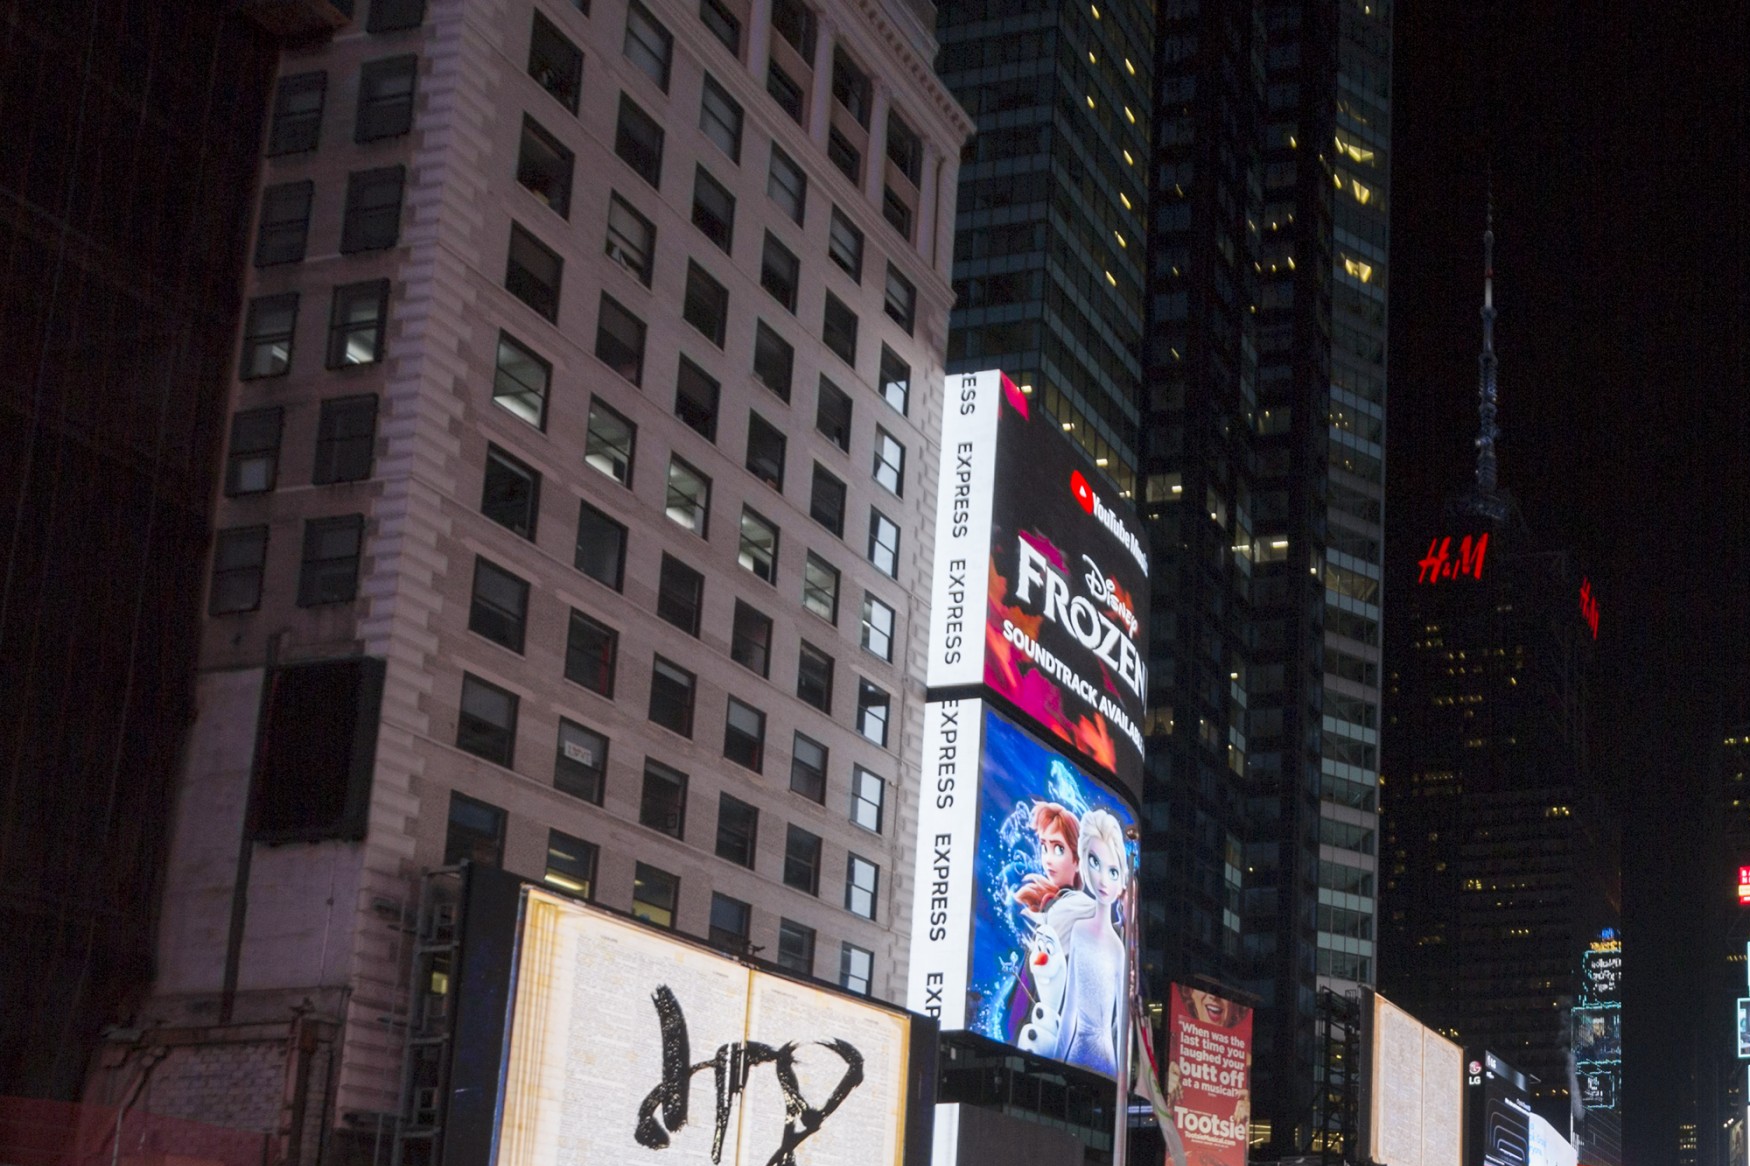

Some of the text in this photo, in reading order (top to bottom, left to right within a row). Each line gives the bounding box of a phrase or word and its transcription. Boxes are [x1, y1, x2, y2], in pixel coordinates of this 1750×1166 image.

[953, 441, 973, 538] EXPRESS
[1418, 532, 1489, 584] H&M
[945, 559, 966, 665] EXPRESS
[1015, 536, 1148, 706] FROZEN
[1003, 618, 1098, 709] SOUNDTRACK
[937, 699, 959, 810] EXPRESS
[929, 832, 952, 943] EXPRESS
[1179, 1043, 1245, 1071] laughed your
[1180, 1030, 1246, 1060] last time you
[1210, 1030, 1246, 1049] was the
[1179, 1056, 1245, 1089] butt off
[1181, 1077, 1200, 1089] at a
[1468, 1076, 1482, 1085] LG
[1173, 1105, 1247, 1141] Tootsie
